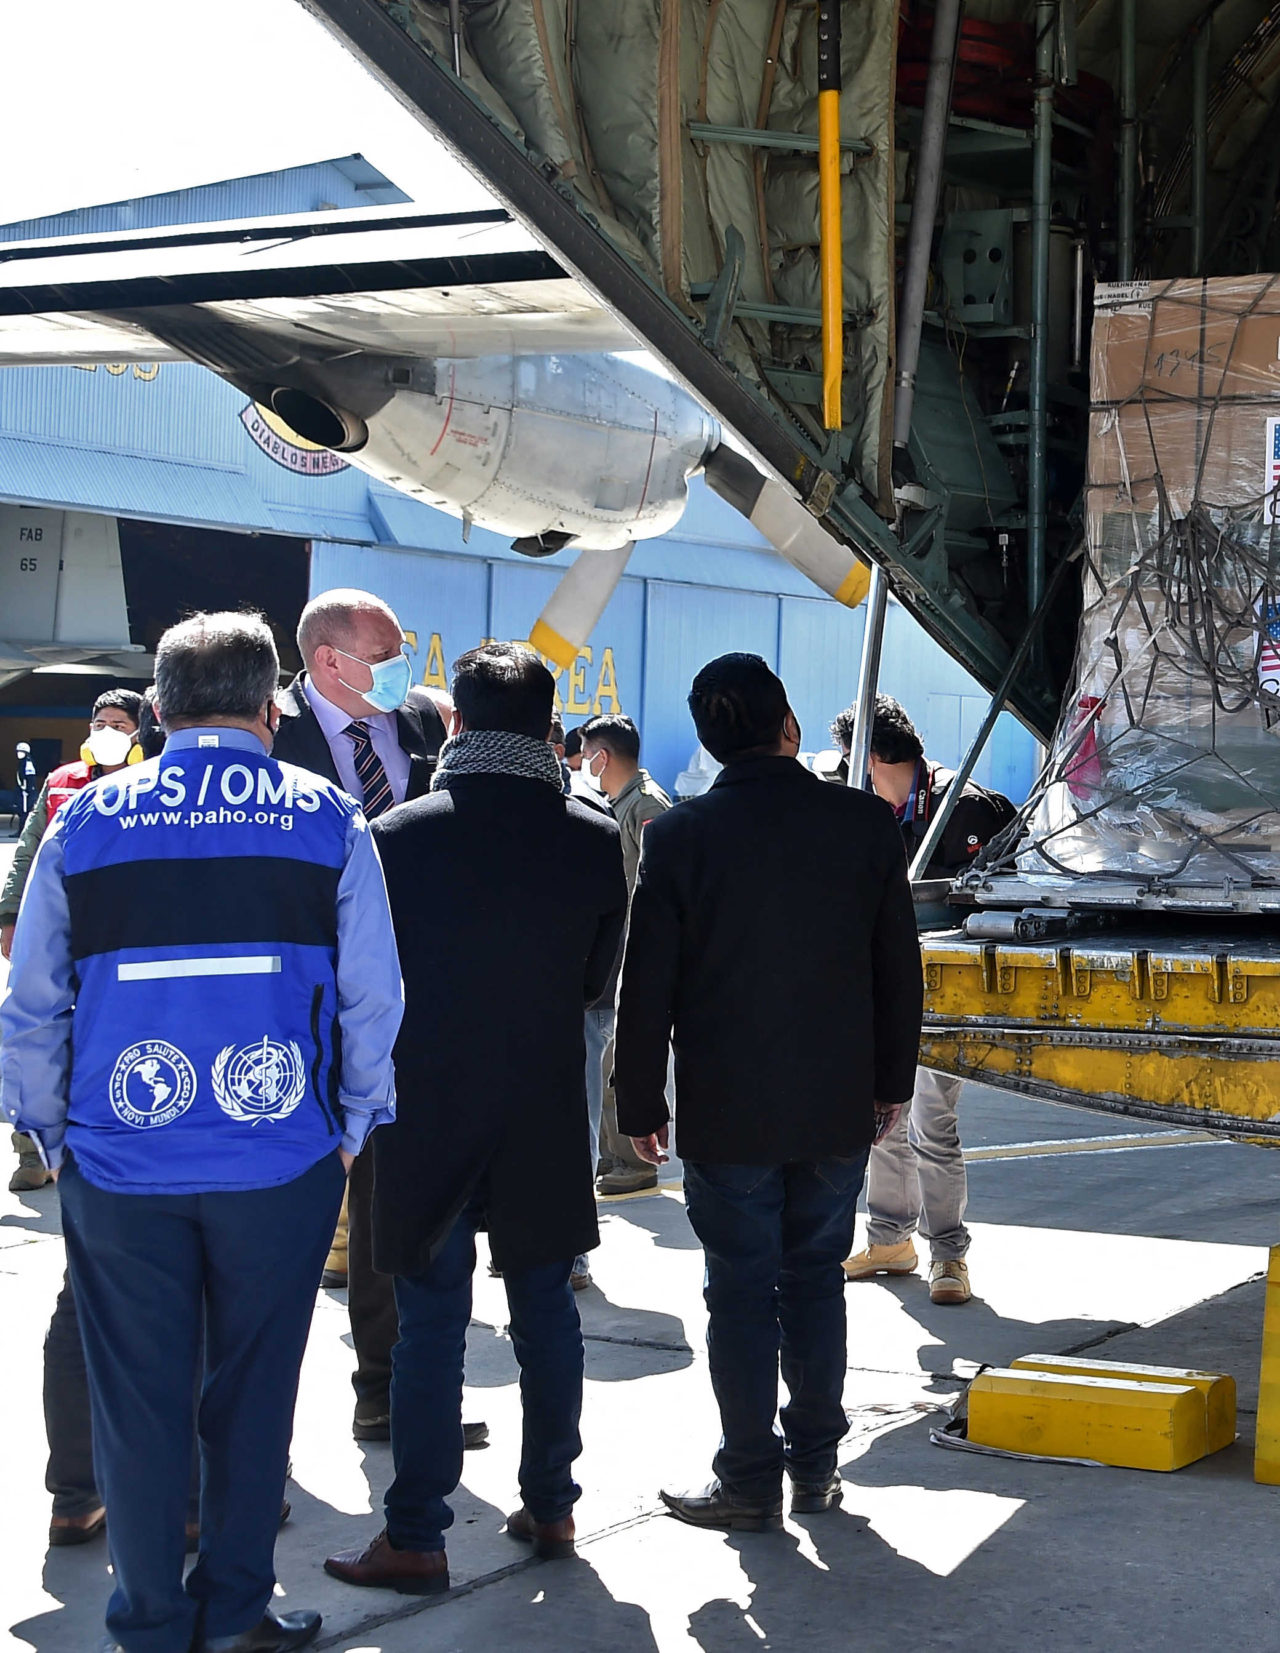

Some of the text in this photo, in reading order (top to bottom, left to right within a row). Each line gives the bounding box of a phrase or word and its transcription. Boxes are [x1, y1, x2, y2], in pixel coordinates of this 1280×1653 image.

[251, 419, 345, 469] DIABLOS NEG
[20, 527, 43, 541] FAB
[20, 558, 38, 572] 65
[917, 789, 927, 814] Canon
[119, 807, 294, 831] www.paho.org
[123, 1044, 180, 1065] PRO SALUTE
[114, 1072, 122, 1098] OPS
[181, 1071, 191, 1098] PAHO
[121, 1106, 180, 1125] NOVI MUNDI
